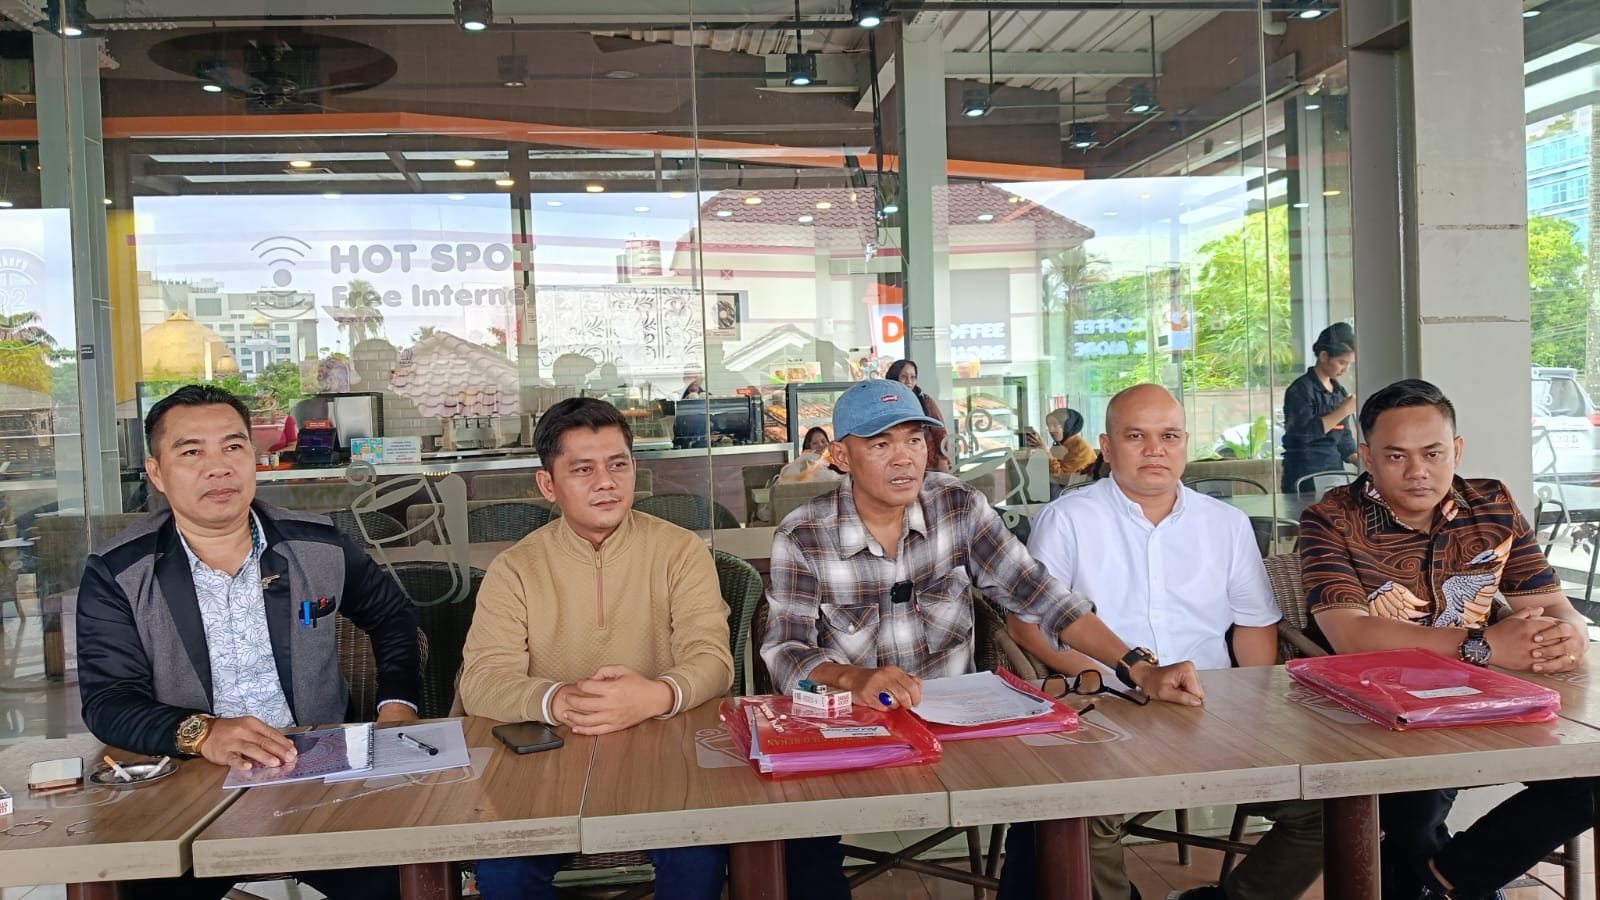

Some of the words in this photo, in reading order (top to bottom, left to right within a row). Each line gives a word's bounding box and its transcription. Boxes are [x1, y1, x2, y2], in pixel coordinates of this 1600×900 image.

[330, 244, 417, 273] HOT
[431, 243, 536, 272] SPOT
[332, 285, 402, 308] Free
[949, 322, 1006, 340] OFFEE
